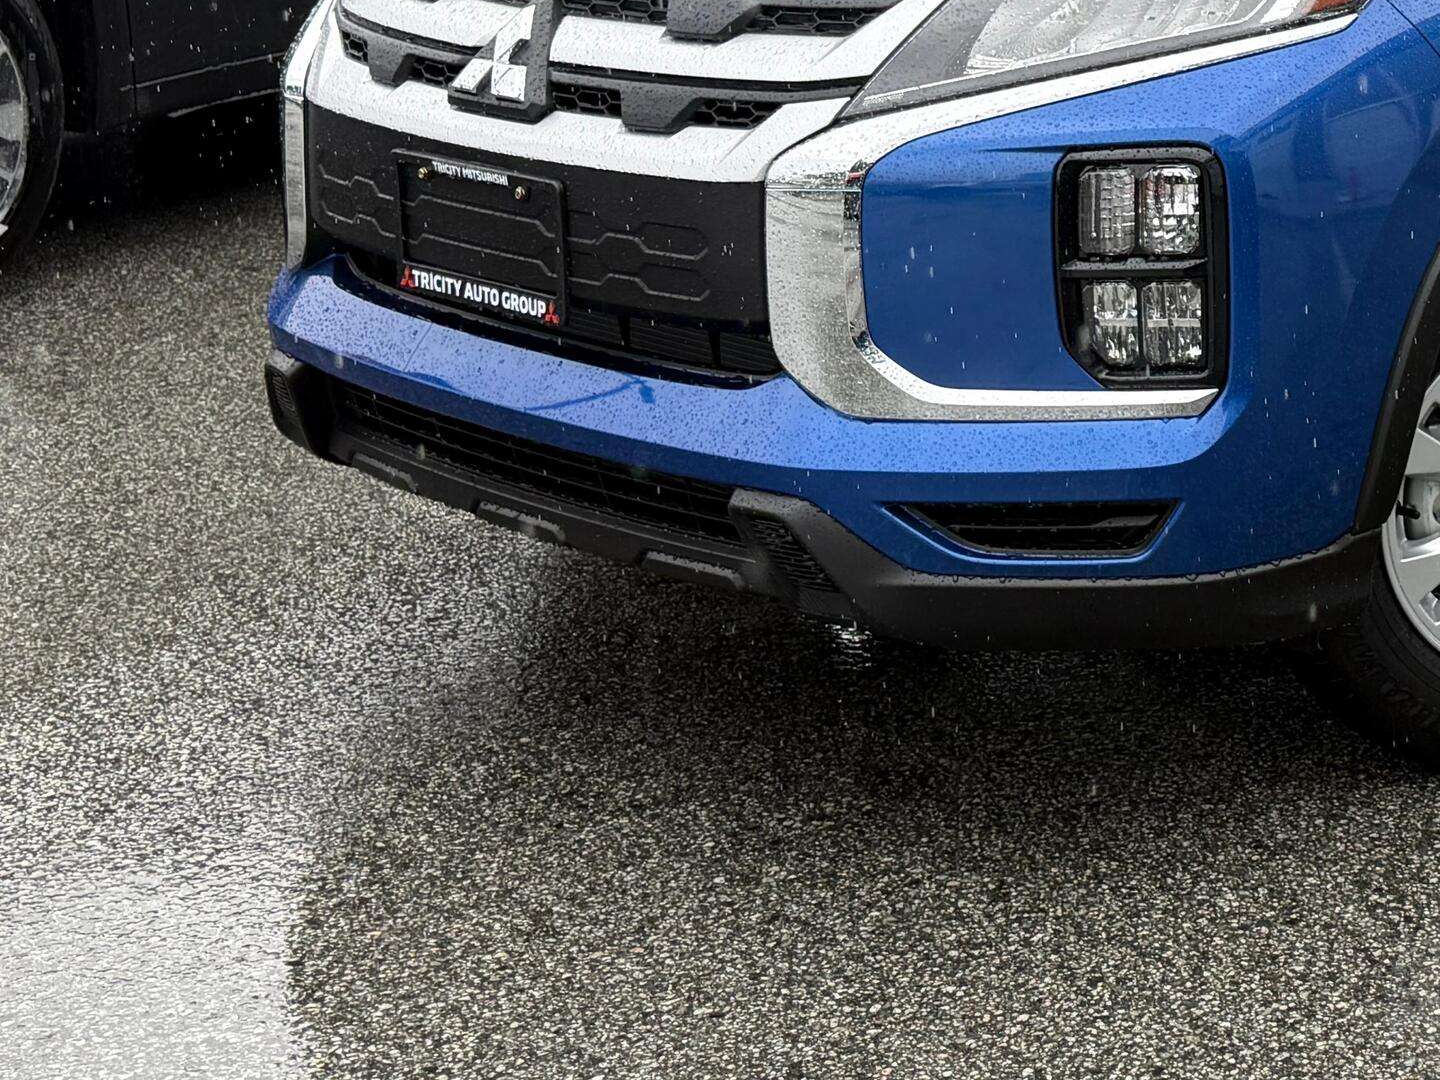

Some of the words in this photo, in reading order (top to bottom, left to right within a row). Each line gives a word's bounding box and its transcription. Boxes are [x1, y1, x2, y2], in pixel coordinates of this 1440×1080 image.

[432, 161, 461, 177] TRICITY
[412, 269, 462, 297] TRICITY
[464, 280, 500, 307] AUTO
[501, 291, 547, 318] GROUP
